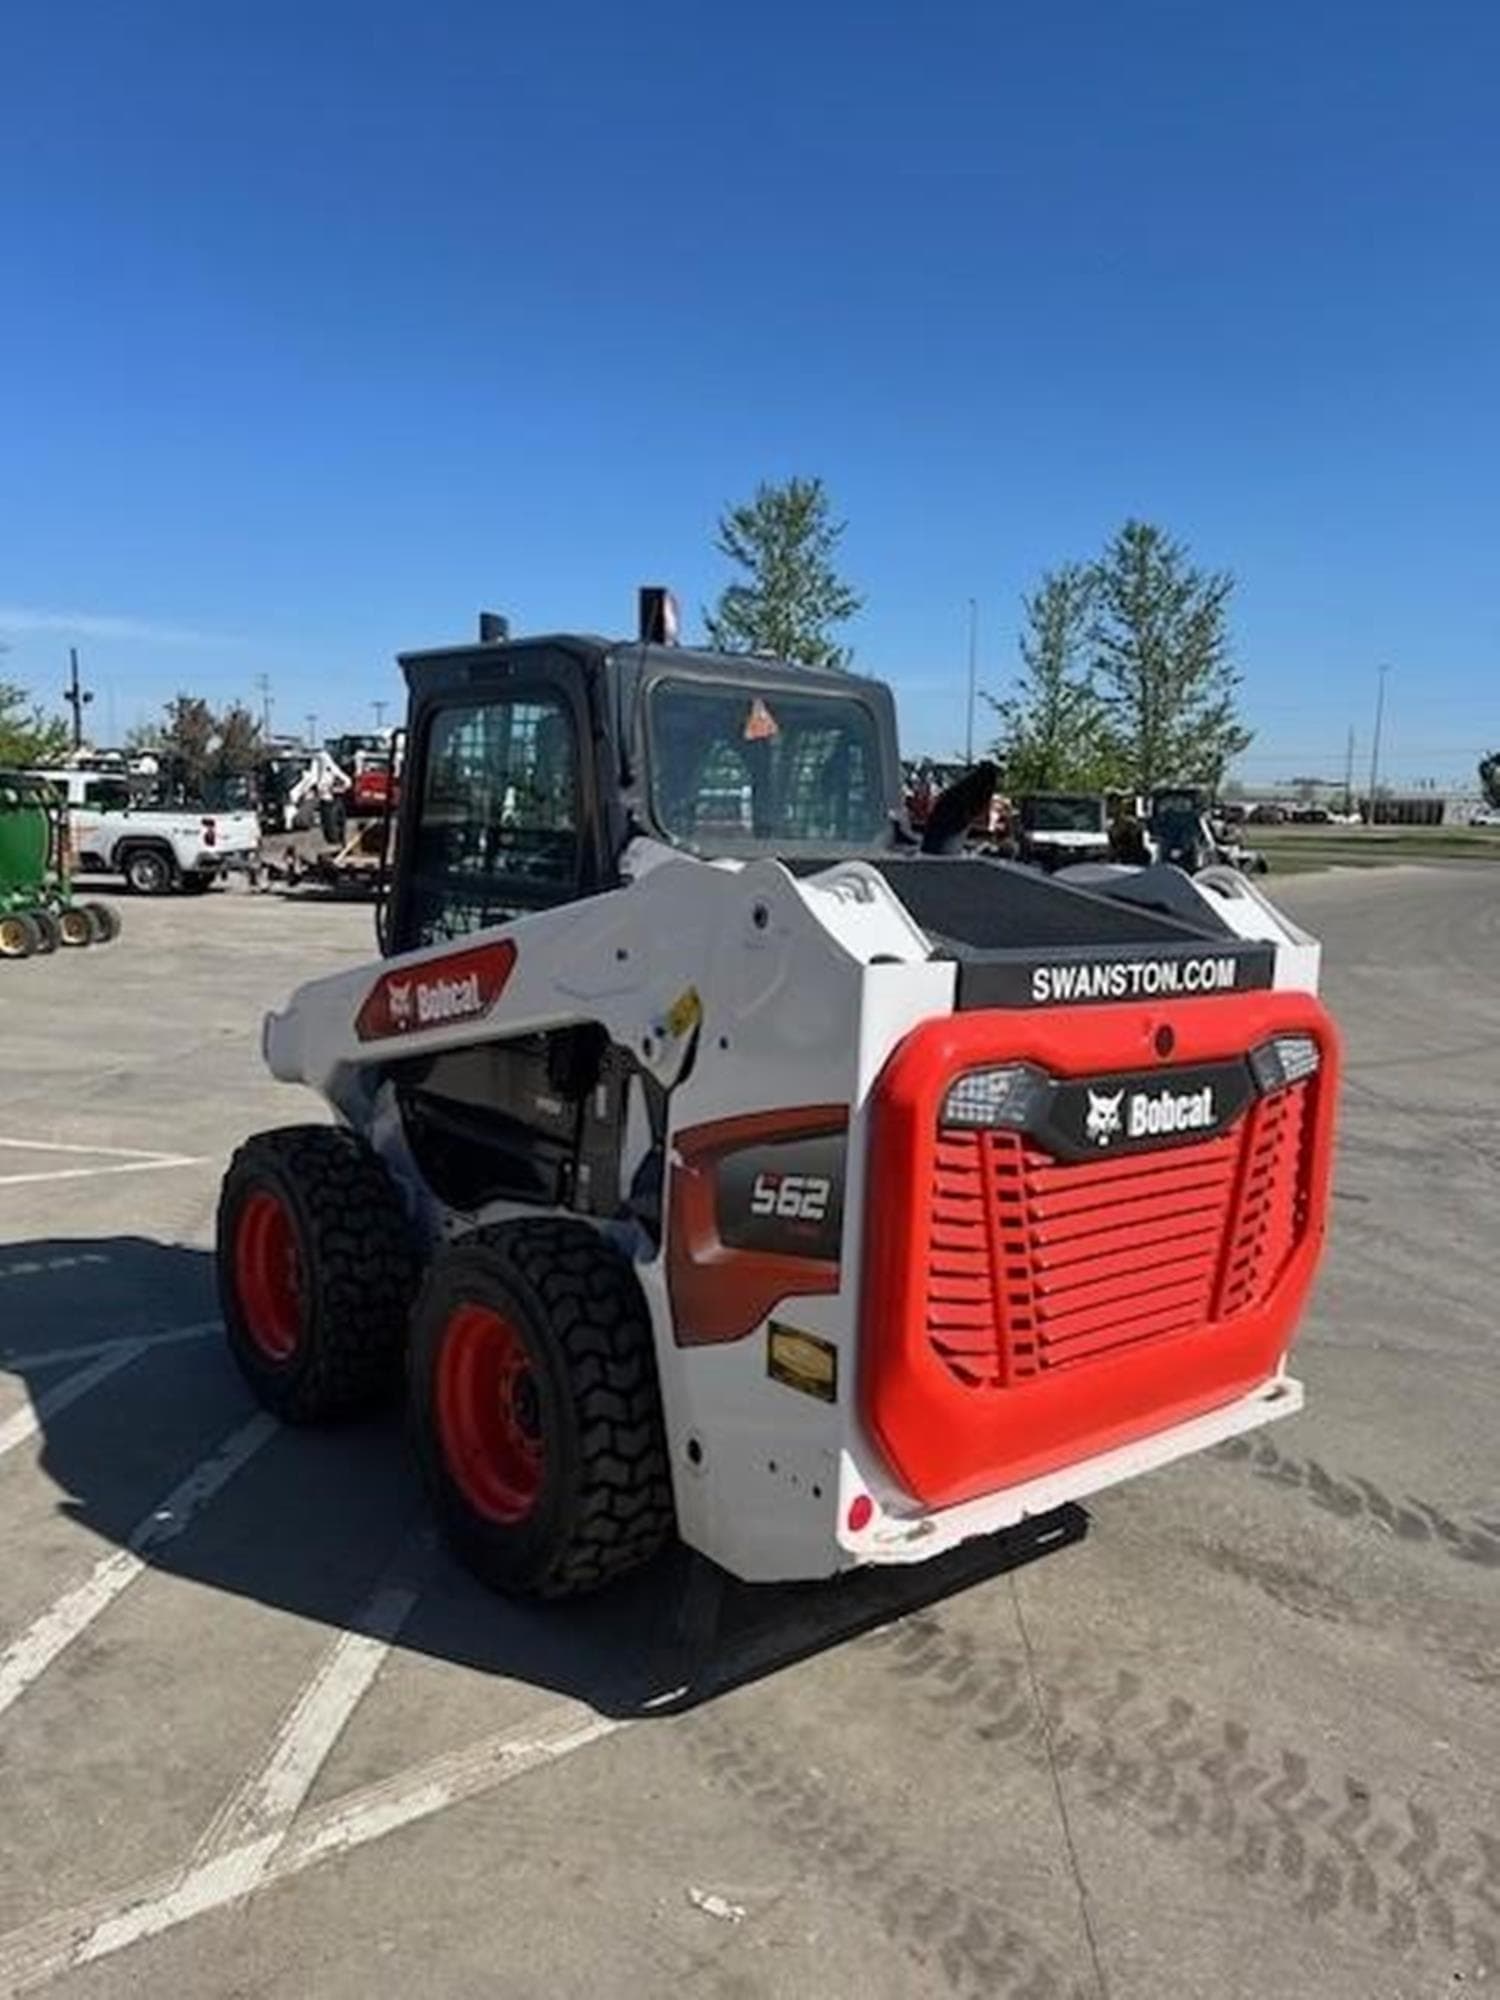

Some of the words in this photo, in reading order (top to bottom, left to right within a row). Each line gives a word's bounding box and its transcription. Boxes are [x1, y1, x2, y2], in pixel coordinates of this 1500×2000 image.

[416, 972, 482, 1022] Bobcat
[1032, 959, 1236, 1001] SWANSTON.COM
[1127, 1086, 1216, 1137] Bobcat
[751, 1173, 831, 1219] S62
